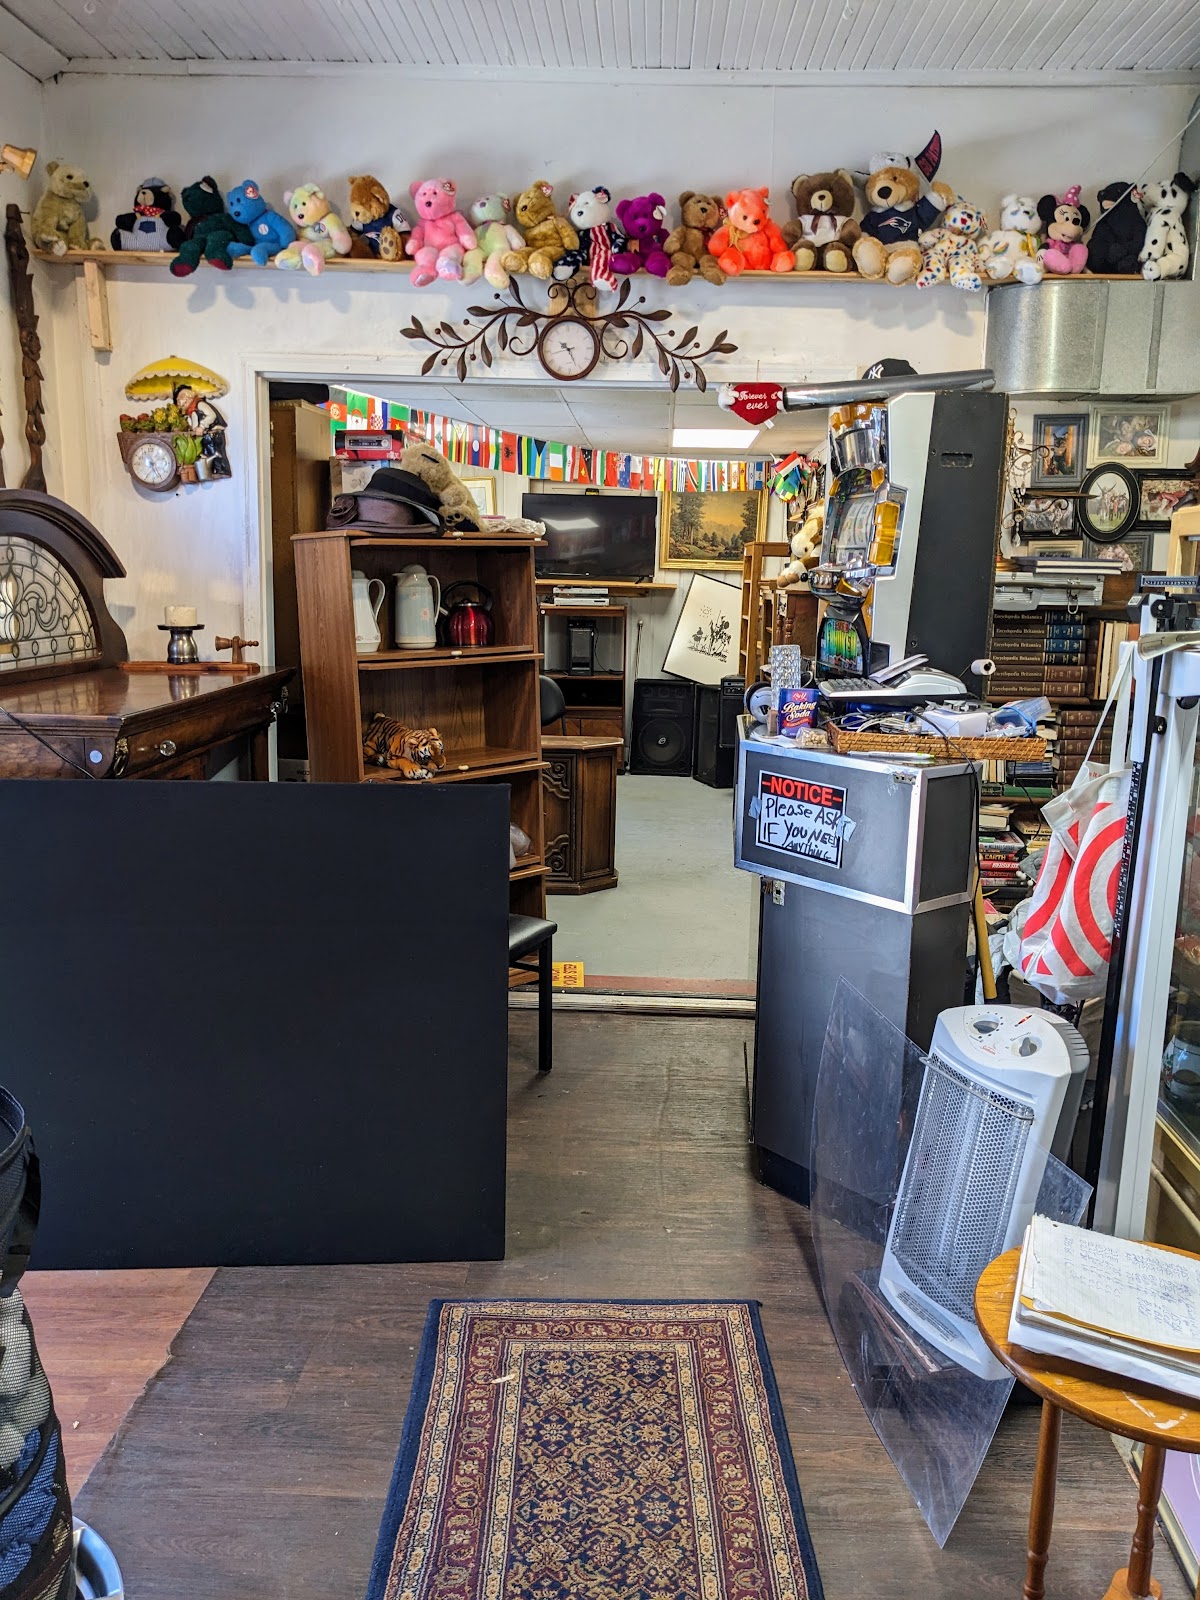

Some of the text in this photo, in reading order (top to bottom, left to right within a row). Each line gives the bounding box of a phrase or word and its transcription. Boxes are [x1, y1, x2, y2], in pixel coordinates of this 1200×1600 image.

[746, 401, 769, 410] ever
[781, 701, 817, 714] Baking
[786, 710, 811, 722] Soda
[765, 796, 813, 818] Please
[763, 822, 780, 842] IF
